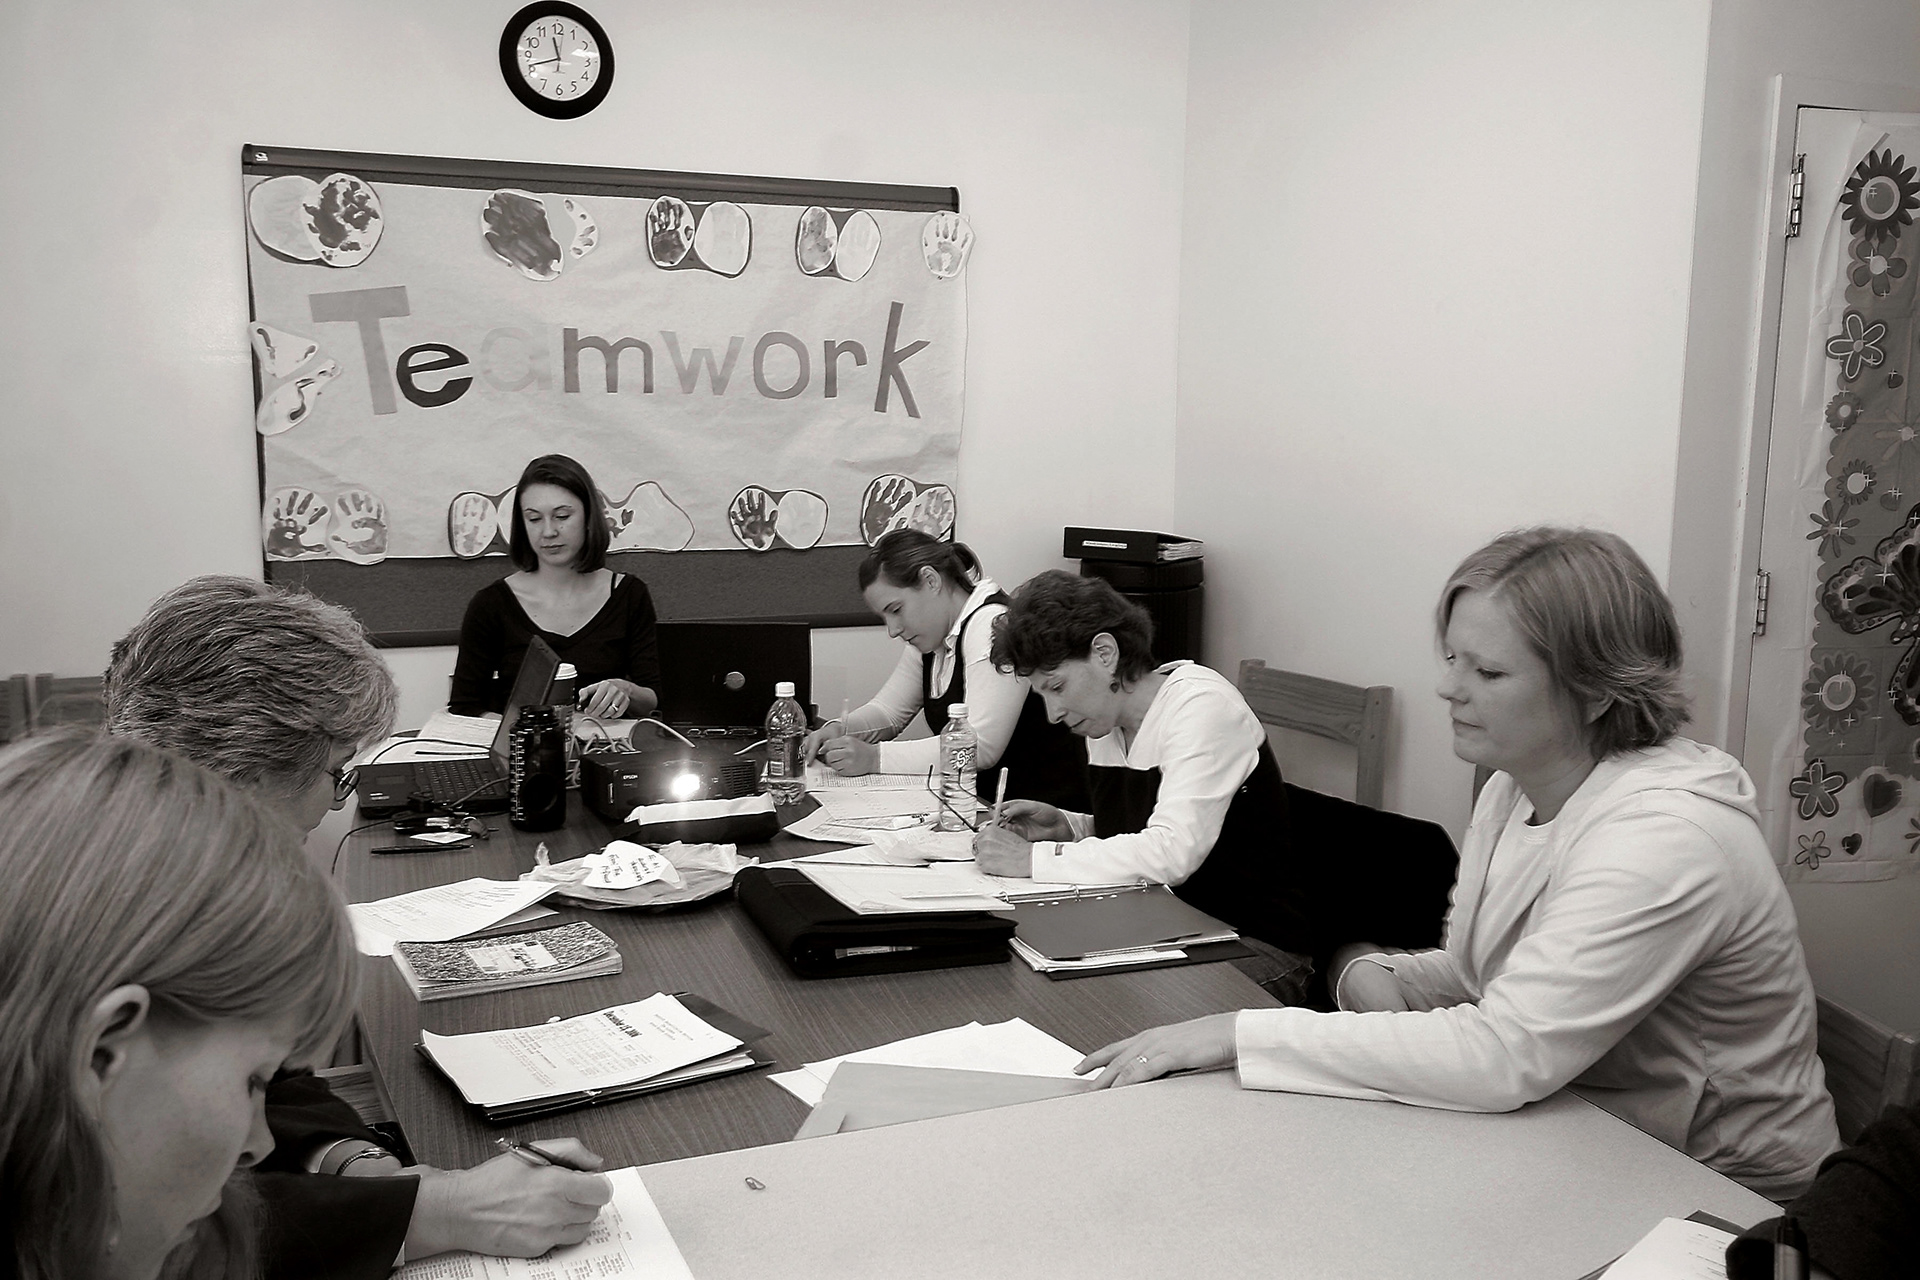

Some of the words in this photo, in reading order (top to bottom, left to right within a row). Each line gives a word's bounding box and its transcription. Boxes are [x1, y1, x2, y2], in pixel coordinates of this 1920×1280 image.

[536, 26, 546, 37] 11
[551, 23, 564, 36] 12
[570, 29, 576, 40] 1
[526, 37, 540, 48] 10
[525, 50, 532, 62] 9
[584, 58, 591, 67] 3
[581, 71, 589, 81] 4
[540, 78, 548, 90] 7
[556, 84, 563, 95] 6
[571, 81, 577, 92] 5
[308, 285, 932, 419] Teamwork
